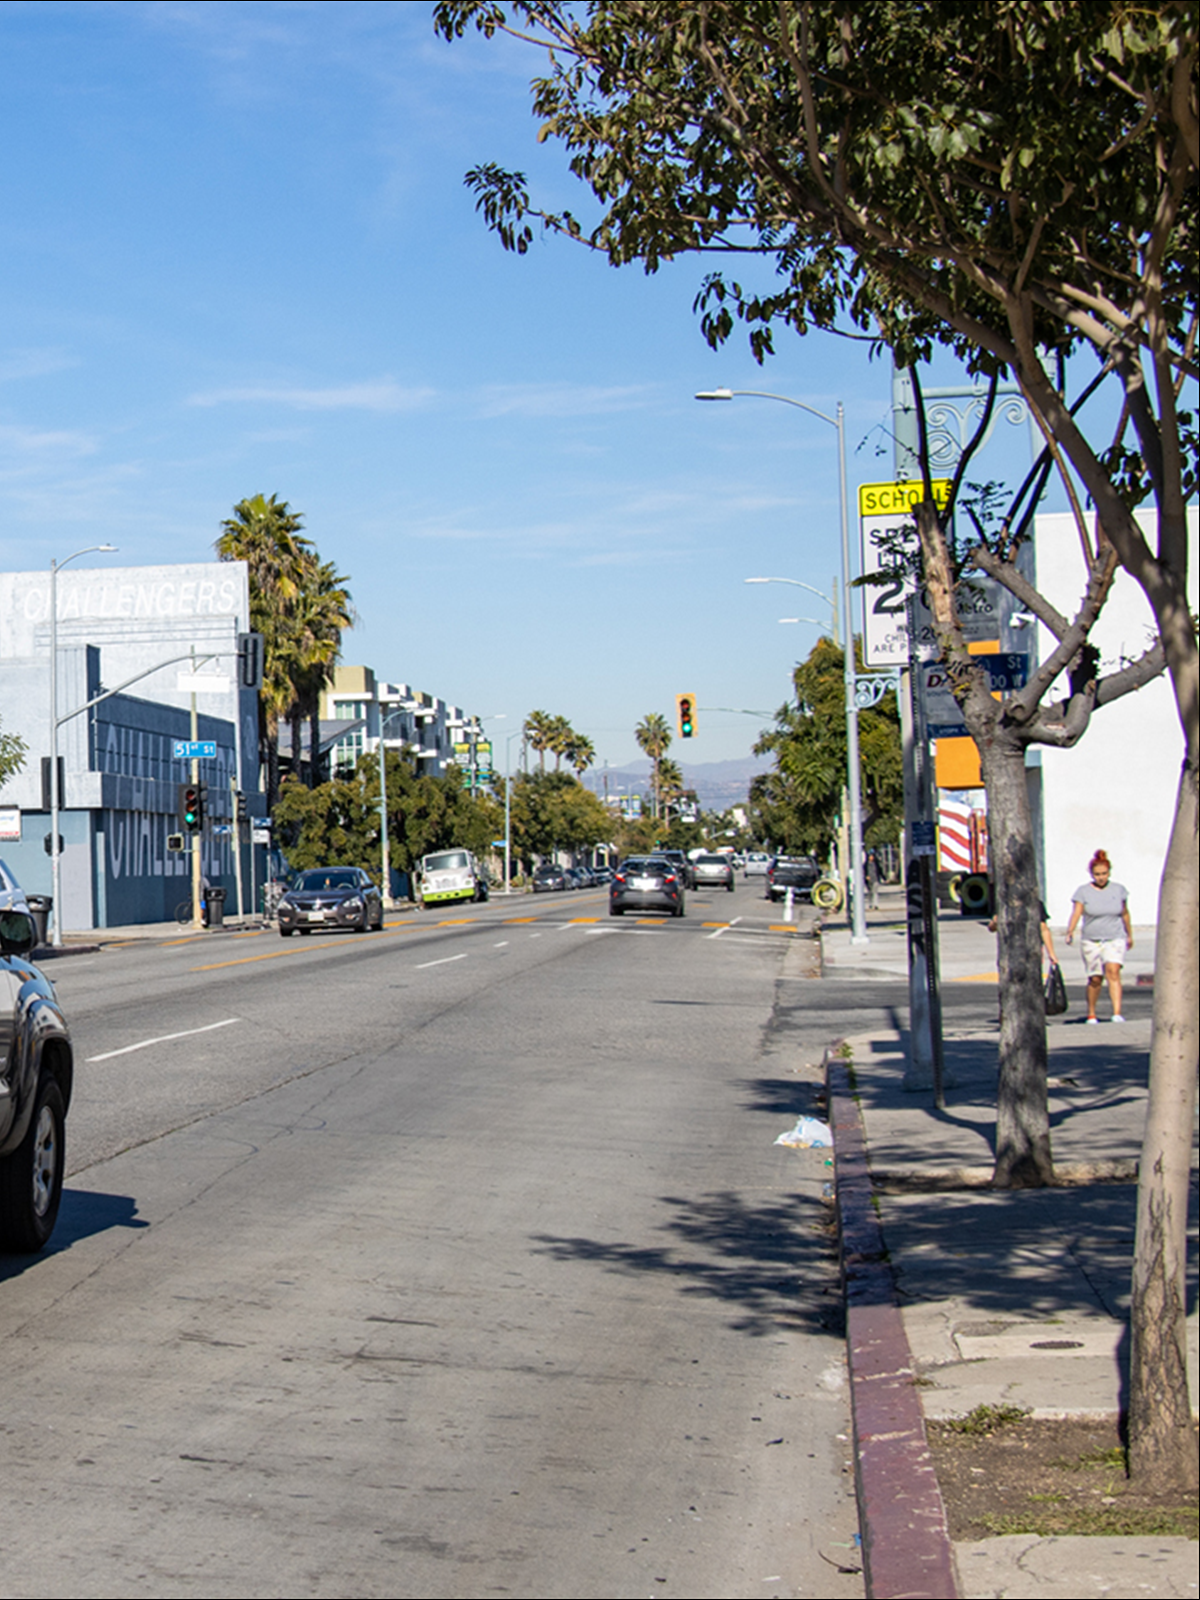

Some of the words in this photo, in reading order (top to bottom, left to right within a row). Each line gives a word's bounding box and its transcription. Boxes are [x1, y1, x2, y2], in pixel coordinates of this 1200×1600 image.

[865, 488, 947, 509] SCHOL
[23, 579, 237, 621] CHALLENGERS
[1007, 656, 1022, 669] St
[176, 743, 199, 756] 51st
[203, 744, 214, 754] St
